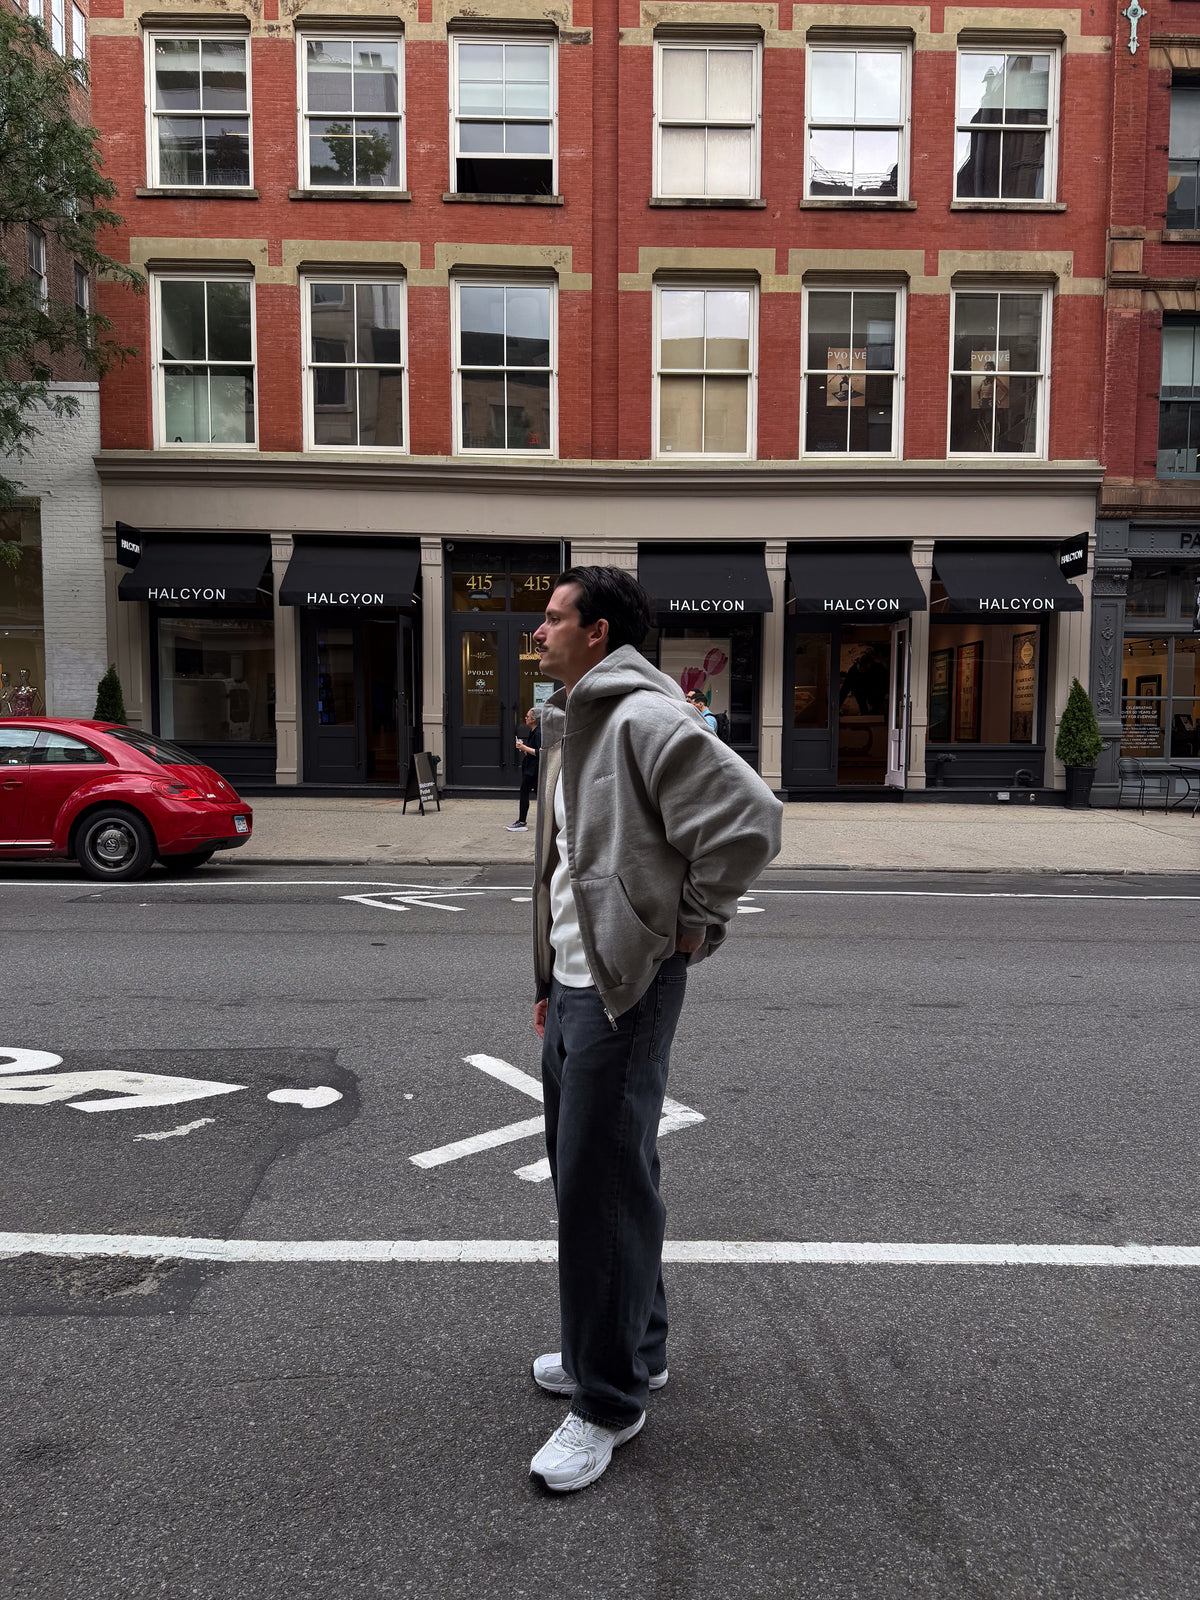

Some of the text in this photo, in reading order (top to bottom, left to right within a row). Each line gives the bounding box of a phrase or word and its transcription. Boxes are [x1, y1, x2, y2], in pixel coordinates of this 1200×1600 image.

[121, 539, 140, 554] HALCYON
[1060, 549, 1083, 565] HALCYON
[466, 575, 493, 590] 415
[524, 576, 551, 591] 415
[148, 588, 226, 600] HALCYON
[307, 592, 384, 605] HALCYON
[670, 599, 745, 612] HALCYON
[823, 598, 900, 611] HALCYON
[979, 598, 1055, 610] HALCYON
